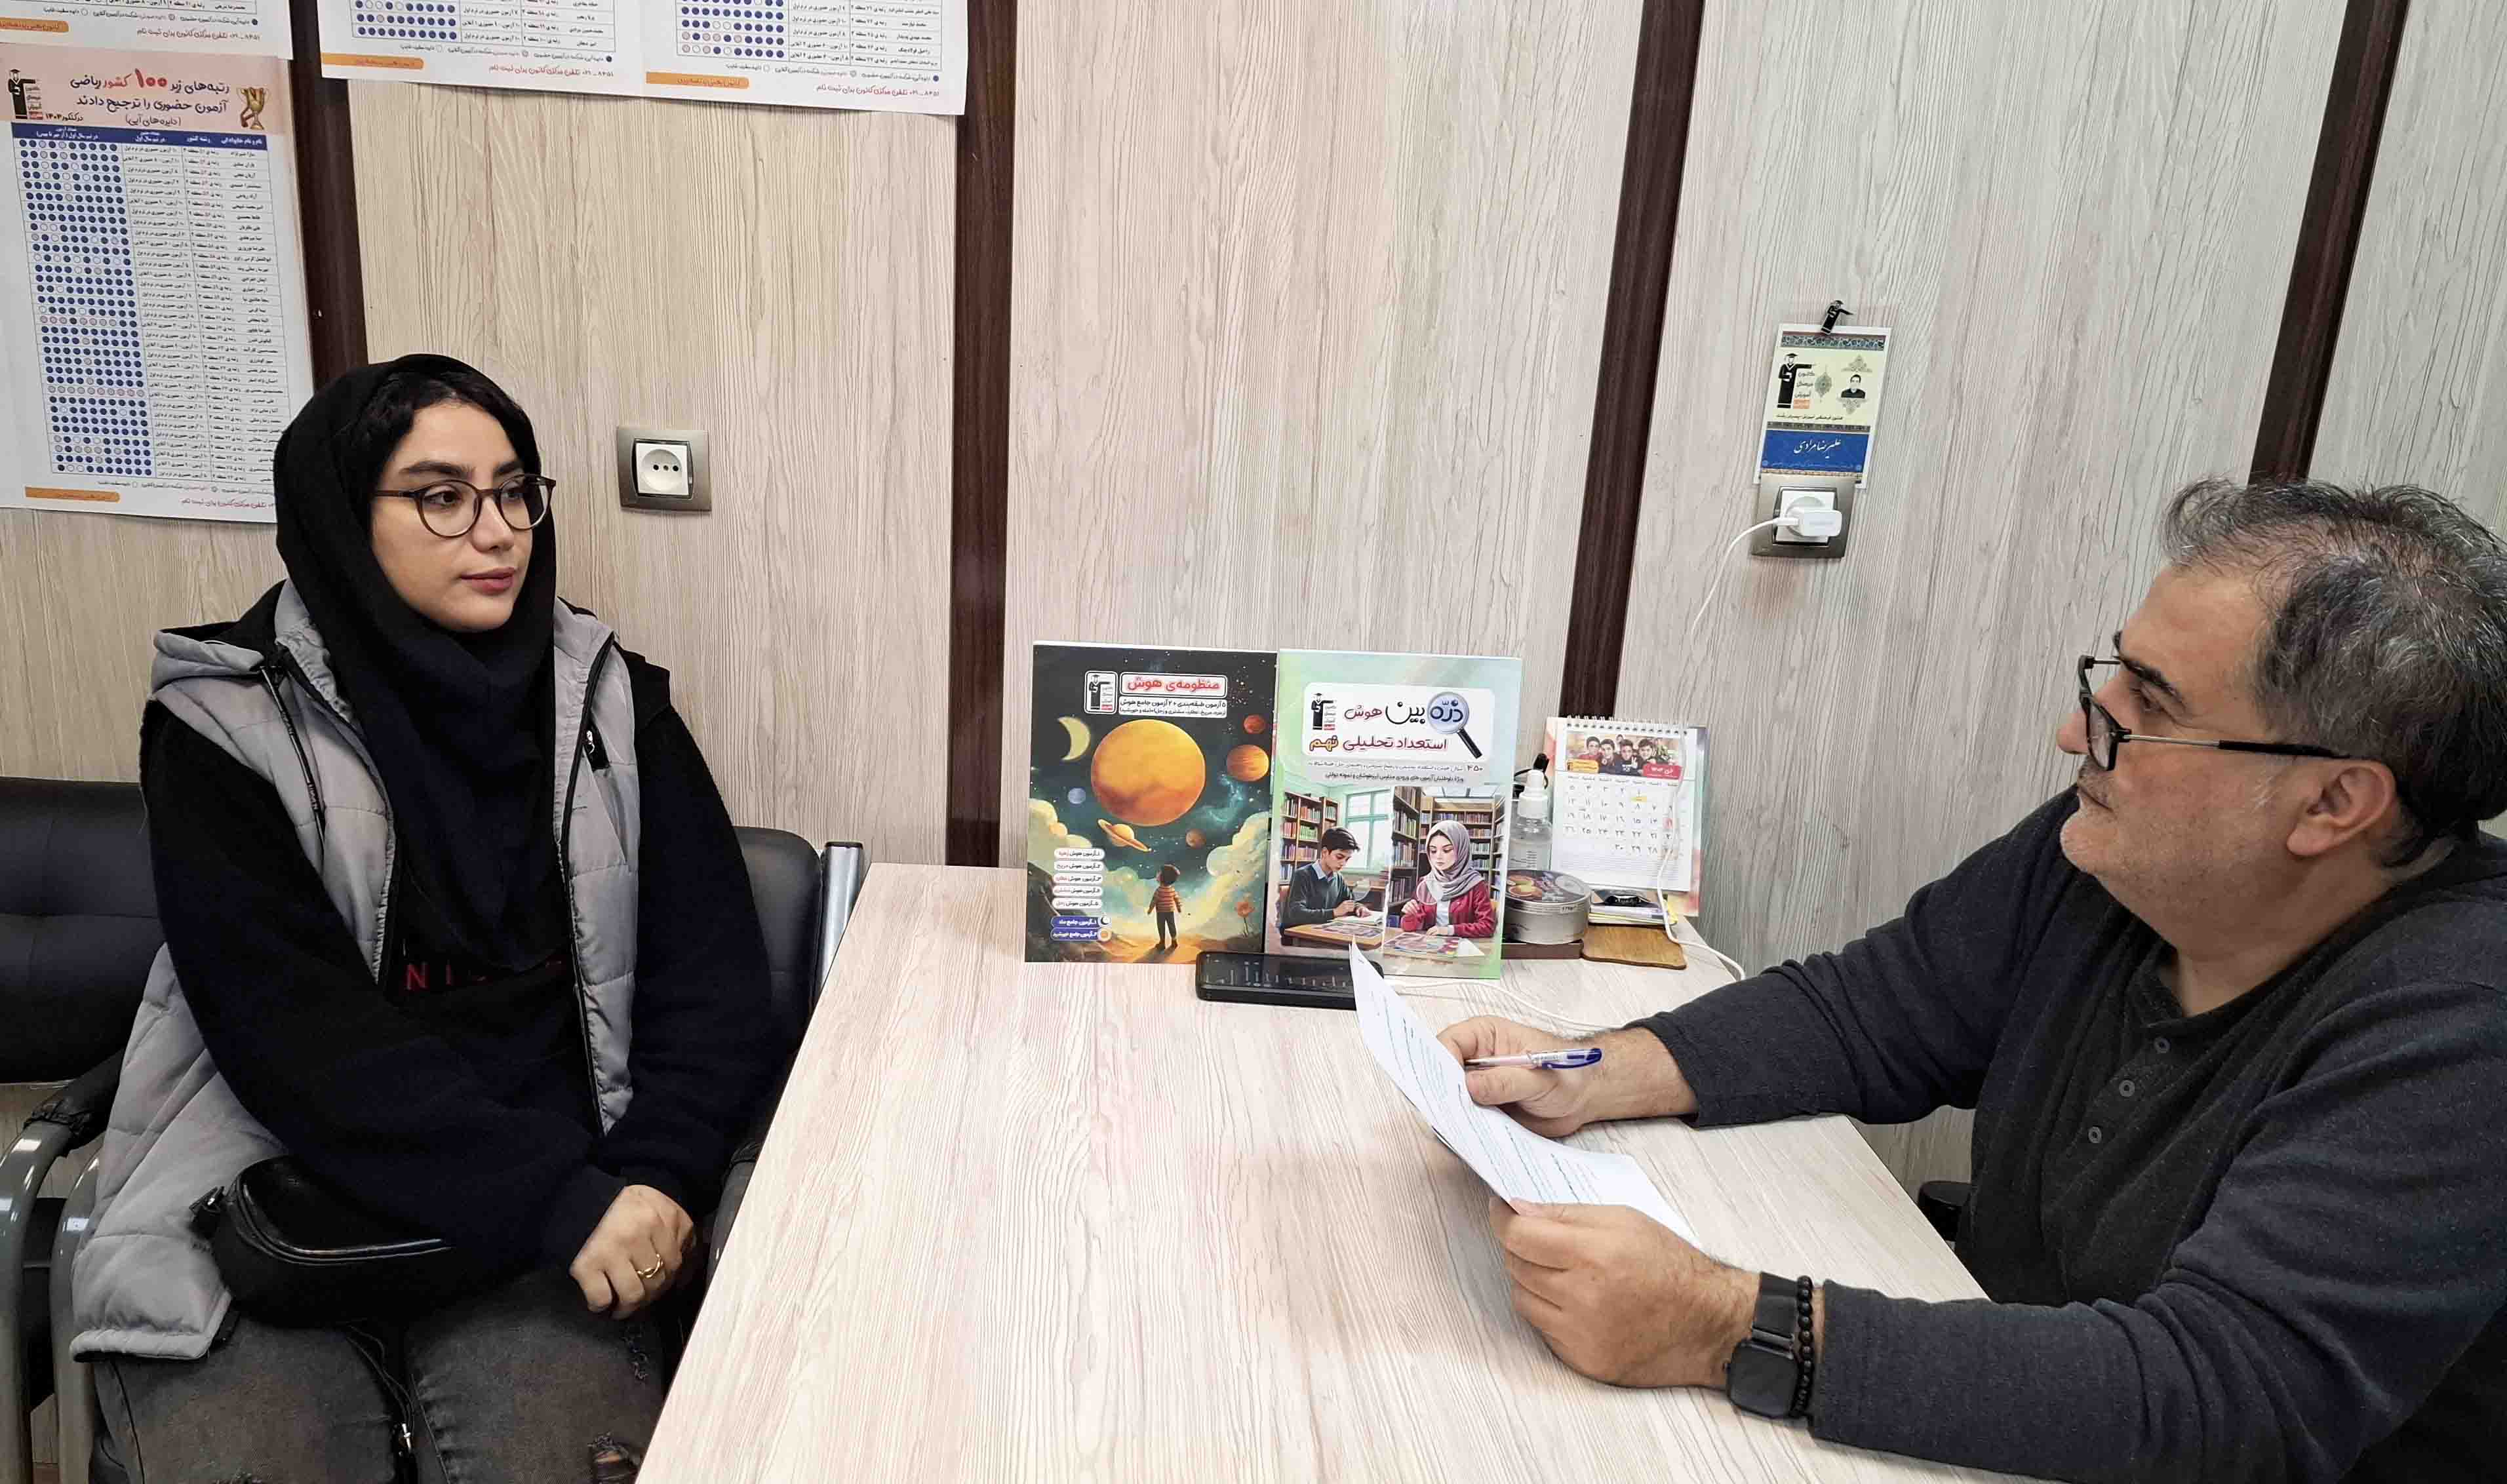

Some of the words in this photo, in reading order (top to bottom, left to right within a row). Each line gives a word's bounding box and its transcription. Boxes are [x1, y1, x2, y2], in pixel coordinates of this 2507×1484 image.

[69, 73, 102, 90] ریاضی
[102, 73, 132, 89] کشور
[134, 68, 168, 88] ۱۰۰
[170, 80, 182, 93] زیر
[76, 95, 105, 106] دادند
[106, 98, 142, 113] ترجیح
[142, 98, 151, 110] را
[153, 100, 192, 111] حضوری
[194, 99, 228, 113] آزمون
[1127, 676, 1162, 691] هوش
[1344, 705, 1383, 720] هوش
[1385, 701, 1426, 725] بین
[1309, 734, 1339, 752] نهم
[1343, 735, 1394, 751] تحلیلی
[1396, 737, 1448, 749] استعداد
